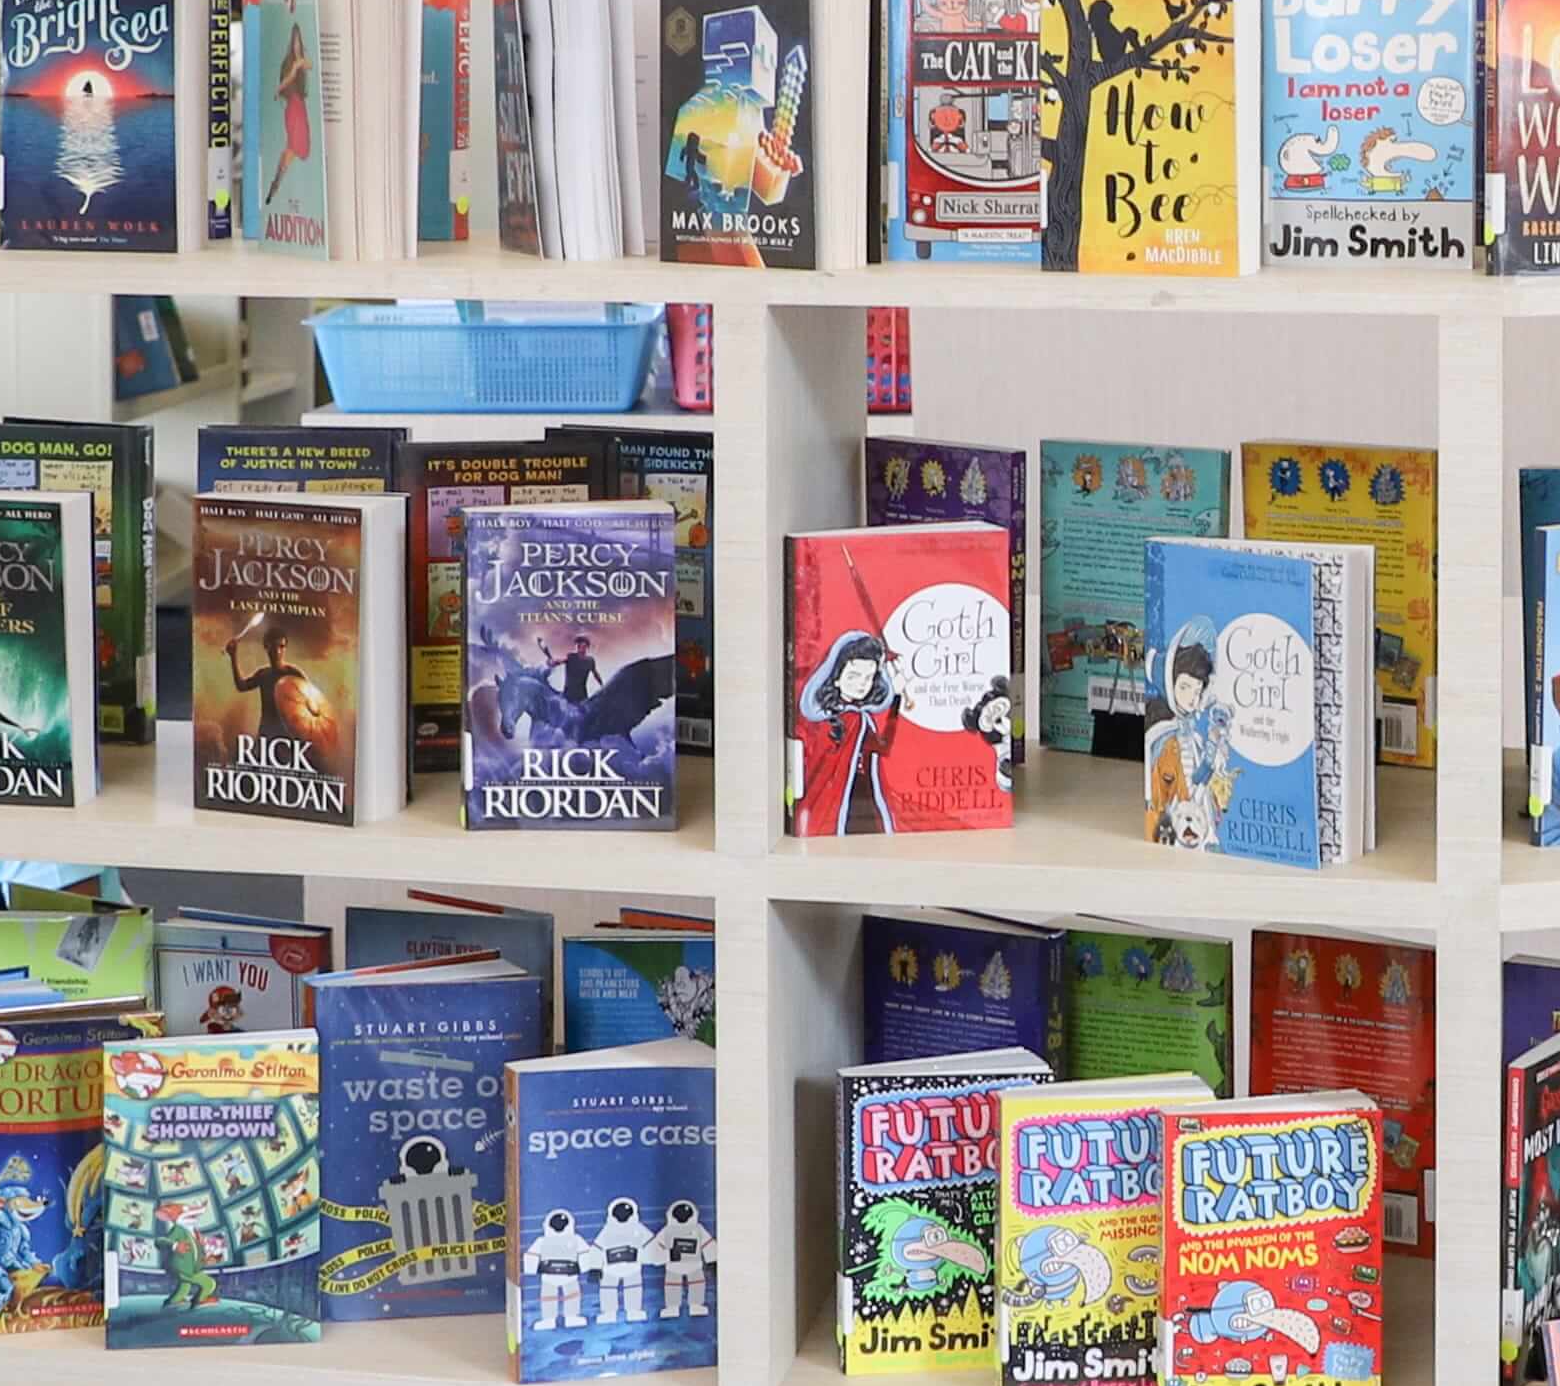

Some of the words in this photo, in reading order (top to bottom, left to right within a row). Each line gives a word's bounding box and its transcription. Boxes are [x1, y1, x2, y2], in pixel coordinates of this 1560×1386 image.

[921, 52, 944, 70] The
[944, 43, 996, 81] CAT
[996, 48, 1013, 62] and
[1273, 29, 1462, 76] Loser
[996, 61, 1013, 77] the
[1287, 77, 1297, 98] I
[1300, 80, 1338, 97] am
[1346, 79, 1389, 97] not
[1395, 82, 1411, 98] a
[1105, 84, 1205, 148] How
[1321, 101, 1381, 123] loser
[1144, 146, 1182, 185] to
[1105, 173, 1194, 239] Bee
[265, 215, 325, 246] AUDITION
[671, 212, 713, 230] MAX
[722, 215, 801, 237] BROOKS
[1270, 223, 1343, 259] Jim
[1346, 223, 1465, 259] Smith
[427, 459, 456, 470] IT'S
[461, 458, 517, 470] DOUBLE
[523, 457, 588, 468] TROUBLE
[453, 472, 483, 483] FOR
[488, 471, 520, 482] DOG
[525, 471, 562, 482] MAN!
[520, 543, 639, 567] PERCY
[474, 559, 670, 605] JACKSON
[900, 597, 997, 644] Goth
[910, 640, 984, 680] Girl
[916, 765, 988, 791] CHRIS
[897, 787, 1004, 814] RIDDELL
[170, 1062, 245, 1081] Geronimo
[250, 1061, 308, 1080] Stilton
[344, 1071, 465, 1103] waste
[150, 1105, 275, 1123] CYBER-THIEF
[369, 1106, 489, 1139] space
[147, 1120, 276, 1140] SHOWDOWN
[528, 1123, 635, 1160] space
[640, 1124, 716, 1145] case
[1180, 1124, 1371, 1187] FUTURE
[1181, 1174, 1368, 1227] RATBOY
[1178, 1250, 1240, 1276] NOM
[1244, 1245, 1320, 1271] NOMS
